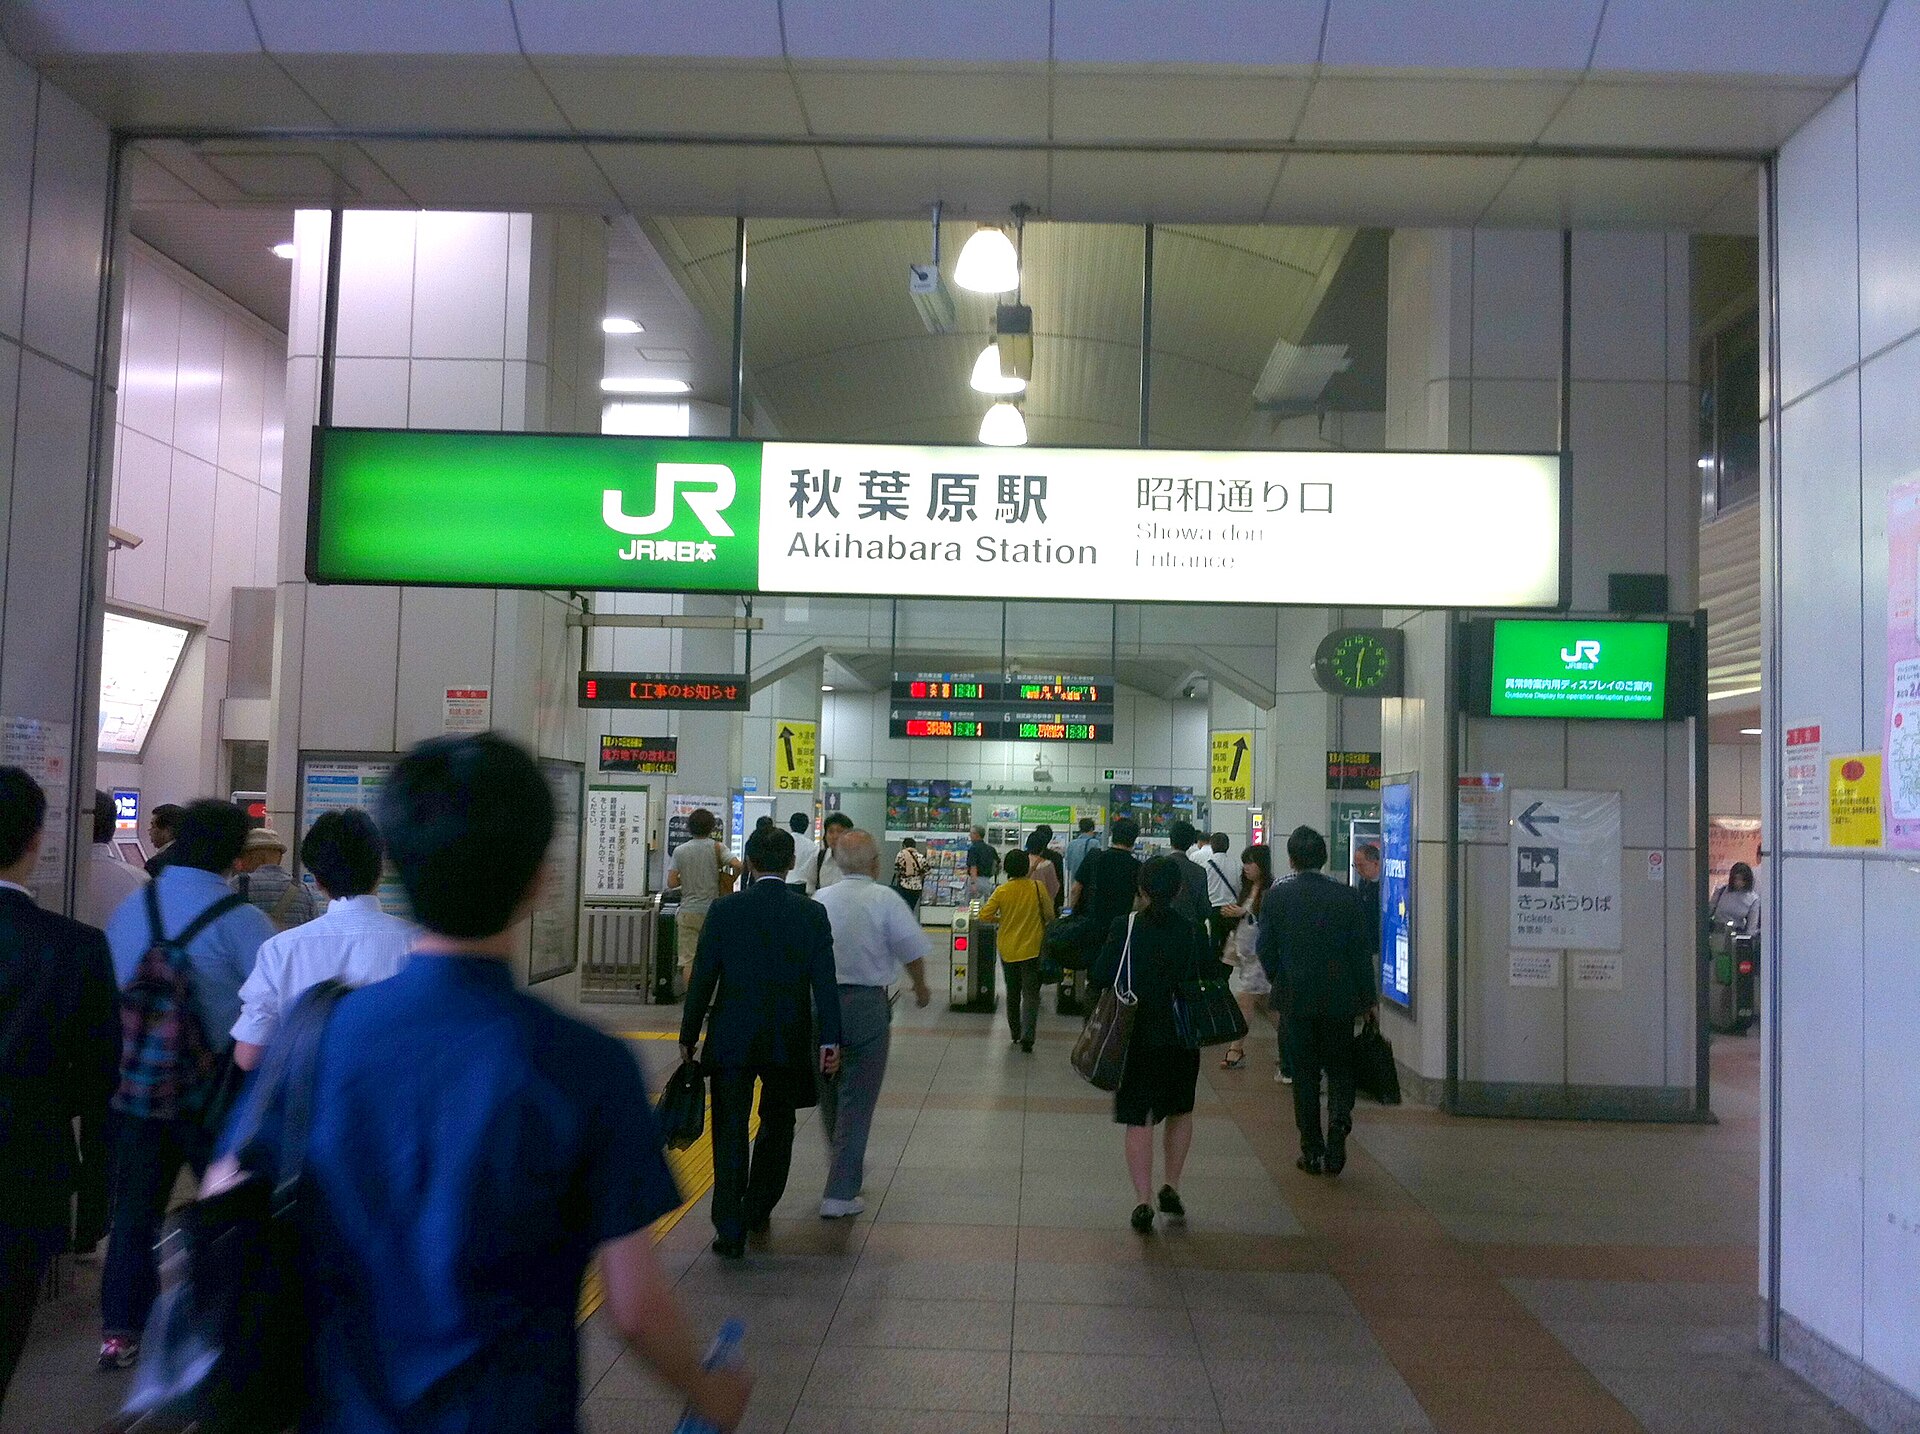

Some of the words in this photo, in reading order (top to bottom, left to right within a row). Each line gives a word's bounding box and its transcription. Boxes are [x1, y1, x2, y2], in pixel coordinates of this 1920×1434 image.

[602, 462, 737, 537] JR
[789, 469, 1048, 524] 秋葉原駅
[1137, 477, 1333, 514] 昭和通り口
[618, 539, 717, 562] JR東日本
[787, 531, 962, 561] Akihabara
[975, 535, 1097, 564] Station
[1561, 640, 1600, 663] JR
[1004, 675, 1012, 683] 5
[630, 682, 737, 699] 【工事のお知らせ
[891, 710, 899, 719] 4
[1004, 713, 1011, 722] 6
[779, 776, 813, 791] 5番線
[1213, 786, 1246, 801] 6番線
[631, 815, 640, 845] ご案内
[1518, 894, 1612, 911] きっぷうりば
[1518, 913, 1553, 924] Tickets
